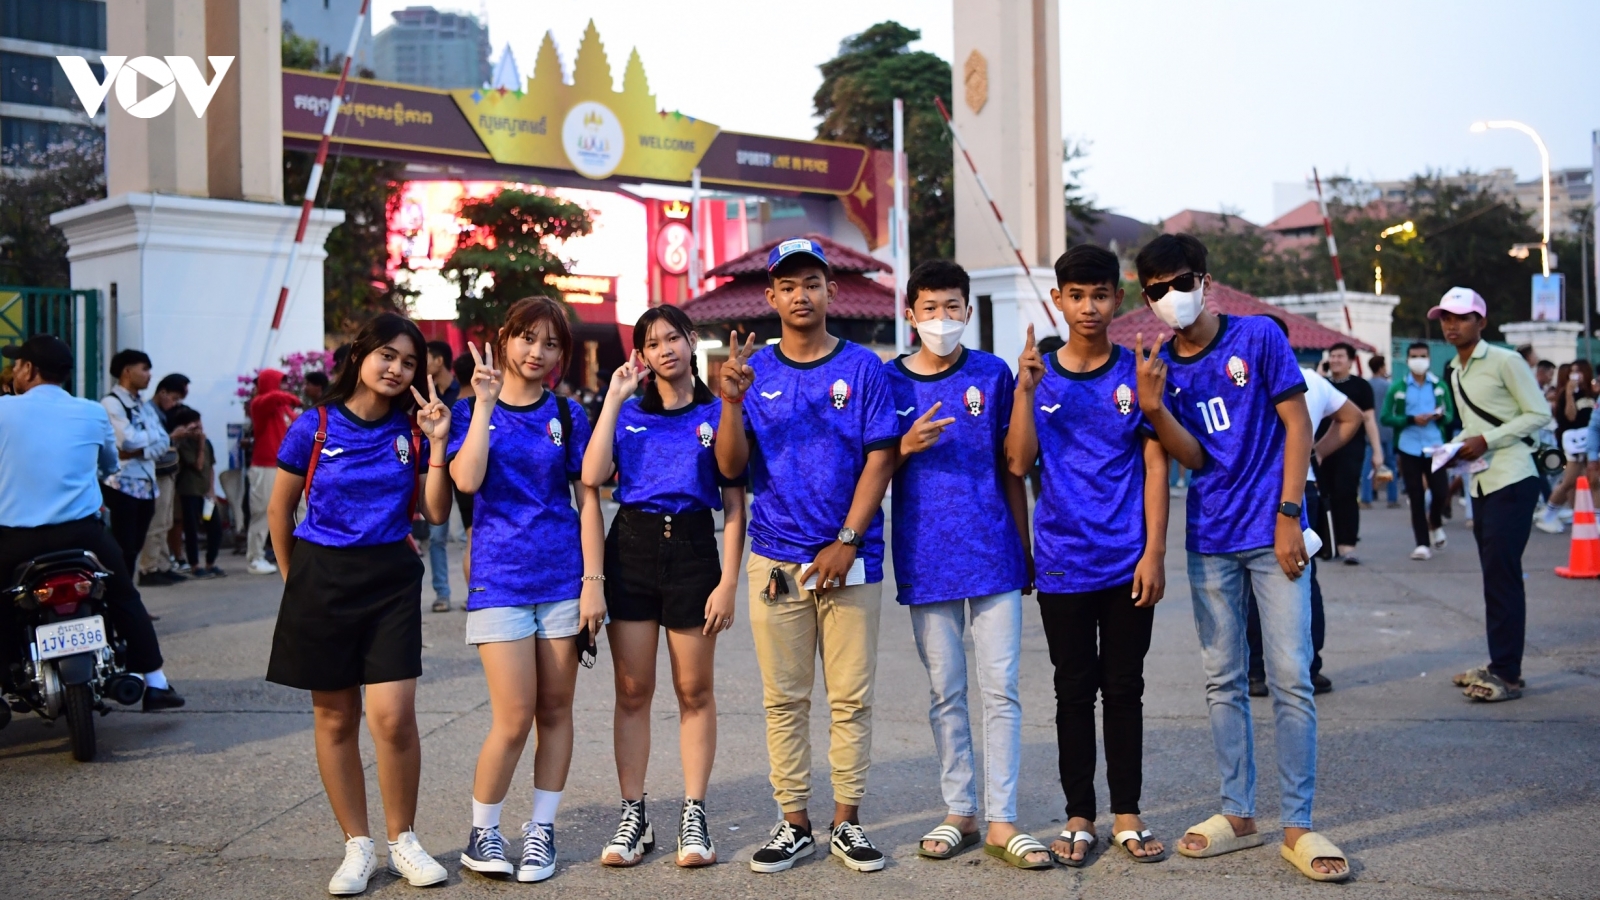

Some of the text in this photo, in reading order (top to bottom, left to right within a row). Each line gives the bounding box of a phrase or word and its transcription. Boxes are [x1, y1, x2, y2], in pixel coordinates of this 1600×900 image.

[638, 135, 696, 153] WELCOME
[736, 150, 771, 167] SPORTS
[1196, 396, 1231, 434] 10
[42, 629, 103, 652] 1JV-6396
